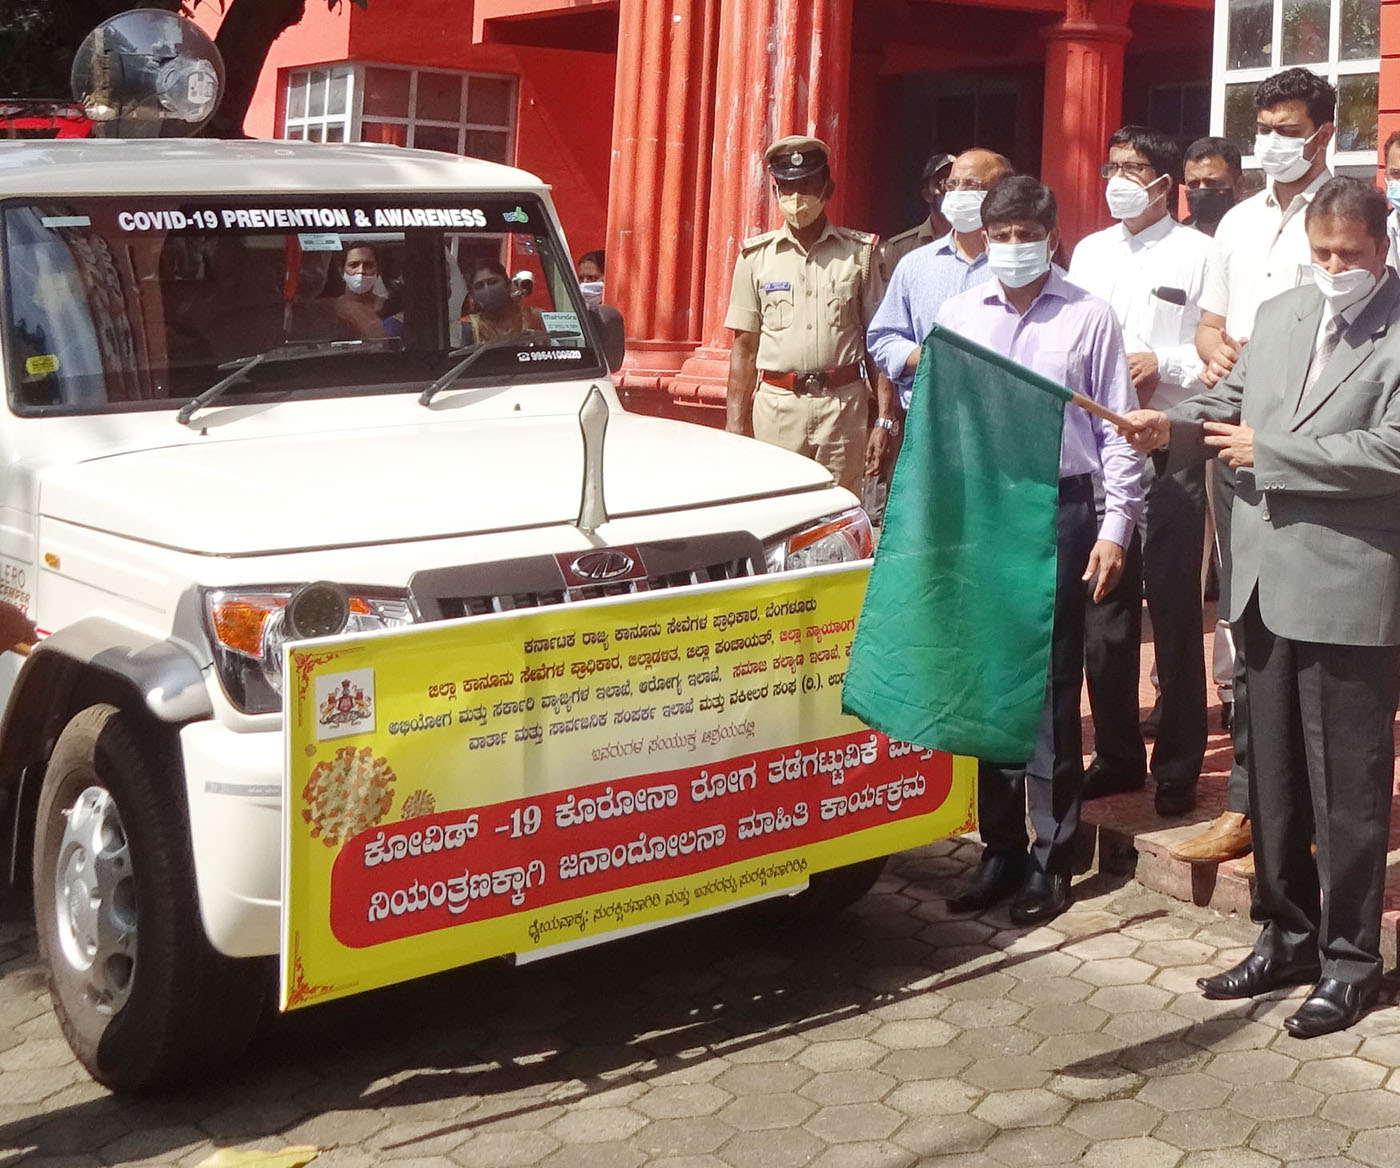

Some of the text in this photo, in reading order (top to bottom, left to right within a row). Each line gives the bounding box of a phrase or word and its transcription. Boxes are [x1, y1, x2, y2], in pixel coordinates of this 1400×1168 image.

[118, 208, 487, 231] COVID-19 PREVENTION & AWARENESS
[428, 682, 457, 701] ಜಿಲ್ಲಾ
[463, 670, 514, 692] ಕಾನೂನು
[520, 661, 566, 684] ಸೇವೆಗಳ
[686, 644, 710, 663] ಜಿಲ್ಲಾ
[779, 629, 801, 645] ಜಿಲ್ಲಾ
[806, 616, 855, 643] ನ್ಯಾಯಾಂಗ
[524, 632, 576, 654] ಕರ್ನಾಟಕ
[582, 631, 609, 651] ರಾಜ್ಯ
[615, 622, 662, 642] ಕಾನೂನು
[667, 615, 707, 635] ಸೇವೆಗಳ
[765, 598, 817, 619] ಬೆಂಗಳೂರು
[388, 710, 452, 736] ಅಭಿಯೋಗ
[459, 704, 487, 726] ಮತ್ತು
[493, 698, 535, 718] ಸರ್ಕಾರಿ
[639, 672, 683, 695] ಆರೋಗ್ಯ
[733, 660, 767, 678] ಸಮಾಜ
[773, 653, 804, 674] ಕಲ್ಯಾಣ
[469, 730, 508, 750] ವಾರ್ತಾ
[515, 723, 543, 745] ಮತ್ತು
[550, 711, 608, 737] ಸಾರ್ವಜನಿಕ
[614, 706, 656, 725] ಸಂಪರ್ಕ
[663, 698, 694, 718] ಇಲಾಖೆ
[700, 695, 725, 714] ಮತ್ತು
[730, 684, 769, 705] ವಕೀಲರ
[773, 679, 797, 696] ಸಂಘ
[591, 719, 755, 761] ಇವರುಗಳ ಸಂಯುಕ್ತ ಆಶ್ರಯದಲ್ಲಿ
[364, 813, 479, 867] ಕೋವಿಡ್
[555, 784, 679, 828] ಕೊರೋನಾ
[690, 759, 757, 802] ರೋಗ
[768, 734, 878, 786] ತಡೆಗಟ್ಟುವಿಕೆ
[368, 770, 926, 922] ನಿಯಂತ್ರಣಕ್ಕಾಗಿ ಜನಾಂದೋಲನಾ ಮಾಹಿತಿ ಕಾರ್ಯಕ್ರಮ
[665, 889, 690, 908] ಮತ್ತು
